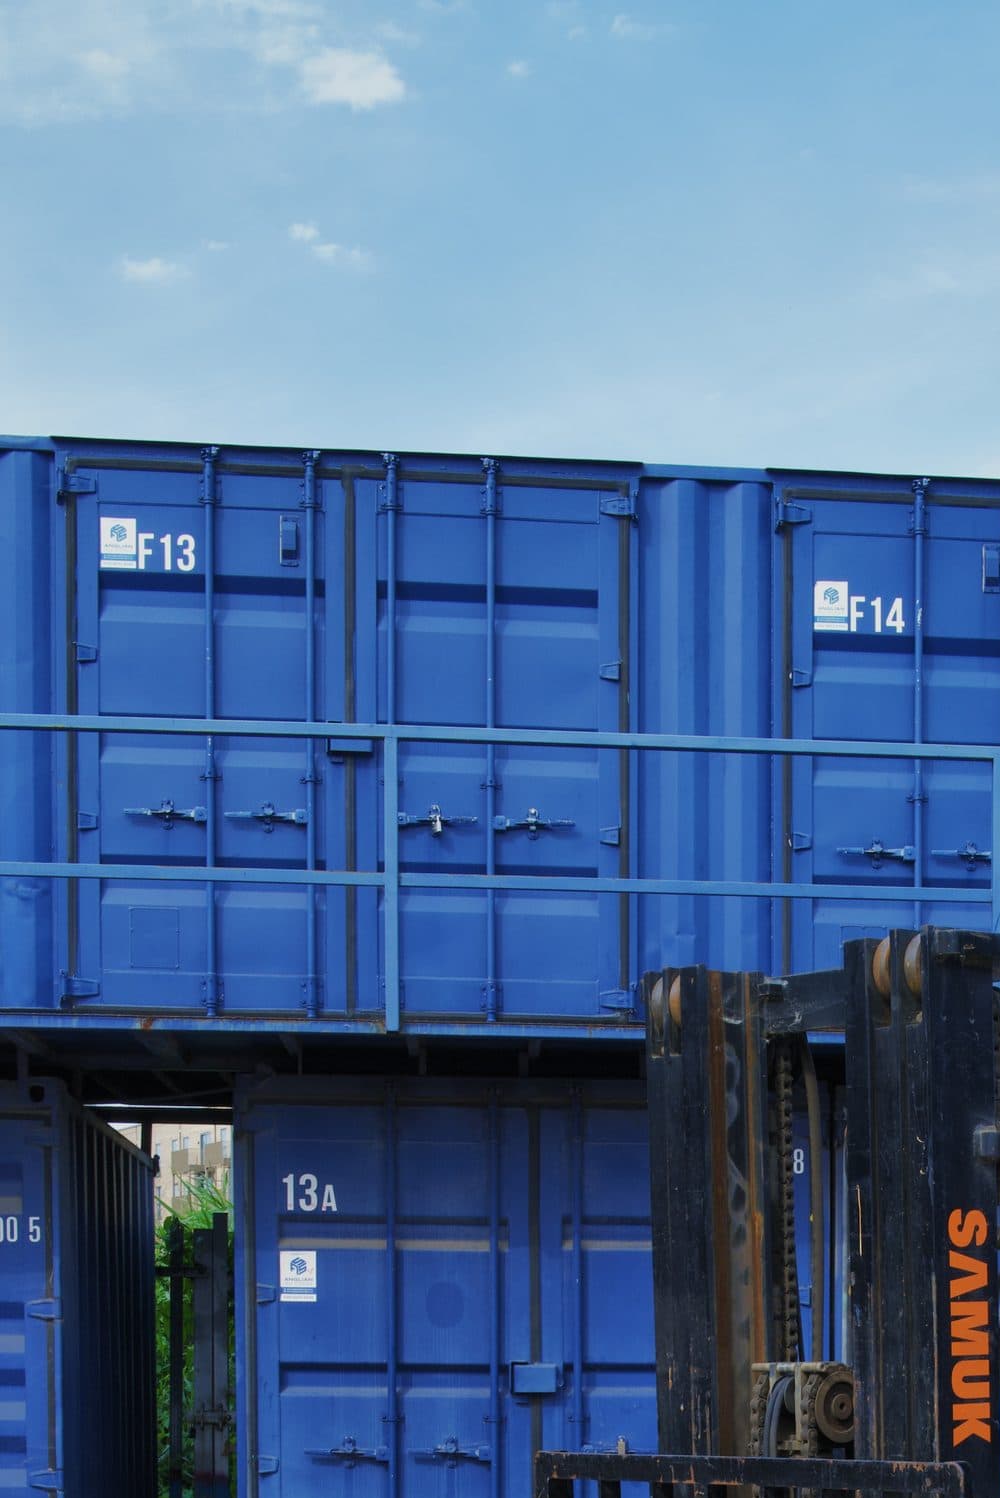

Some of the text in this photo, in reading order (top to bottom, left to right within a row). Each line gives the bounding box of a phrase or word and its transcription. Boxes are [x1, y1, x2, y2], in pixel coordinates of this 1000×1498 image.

[138, 533, 195, 571] F13
[850, 596, 905, 633] F14
[282, 1173, 338, 1212] 13A
[29, 1216, 41, 1242] 5
[948, 1208, 991, 1448] SAMUK
